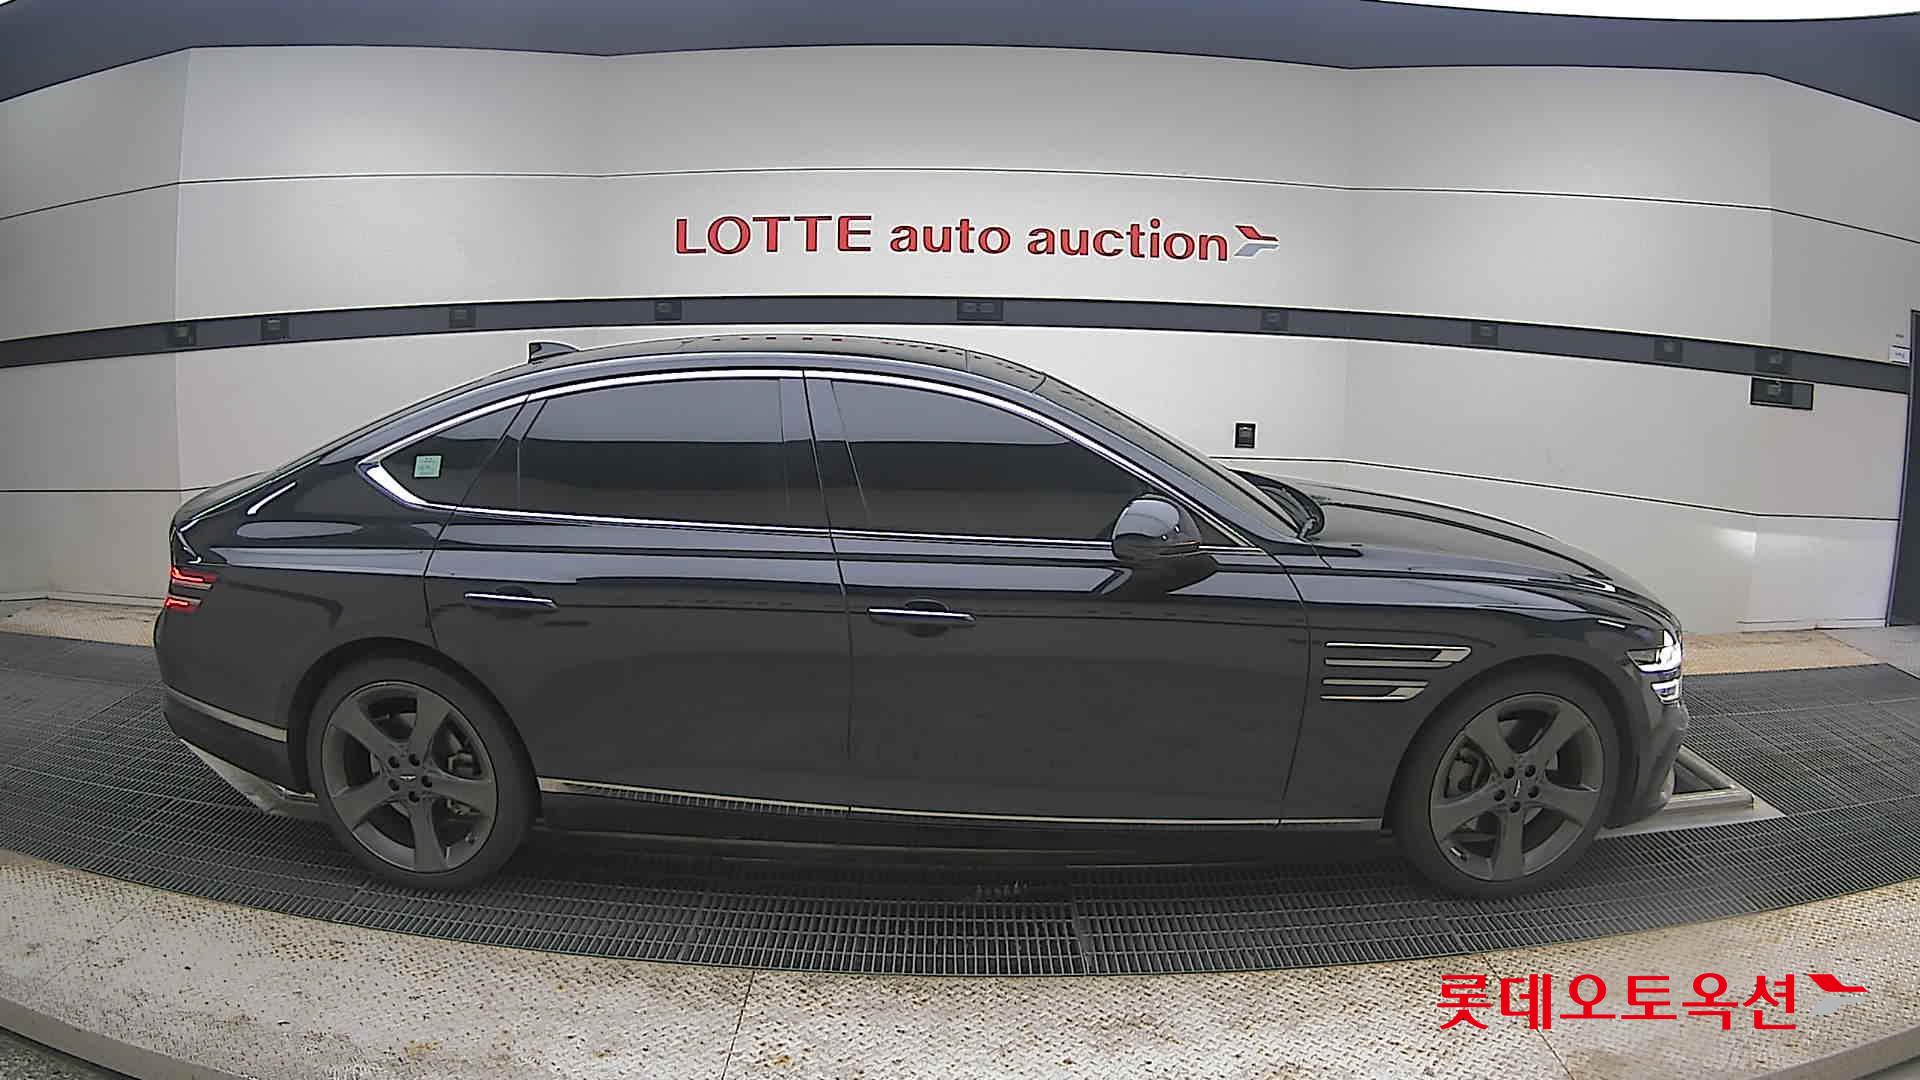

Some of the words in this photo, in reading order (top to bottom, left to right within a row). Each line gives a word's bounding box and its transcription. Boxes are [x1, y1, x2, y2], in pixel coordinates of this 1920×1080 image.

[675, 215, 872, 254] LOTTE
[890, 219, 1011, 254] auto
[1027, 219, 1229, 262] auction
